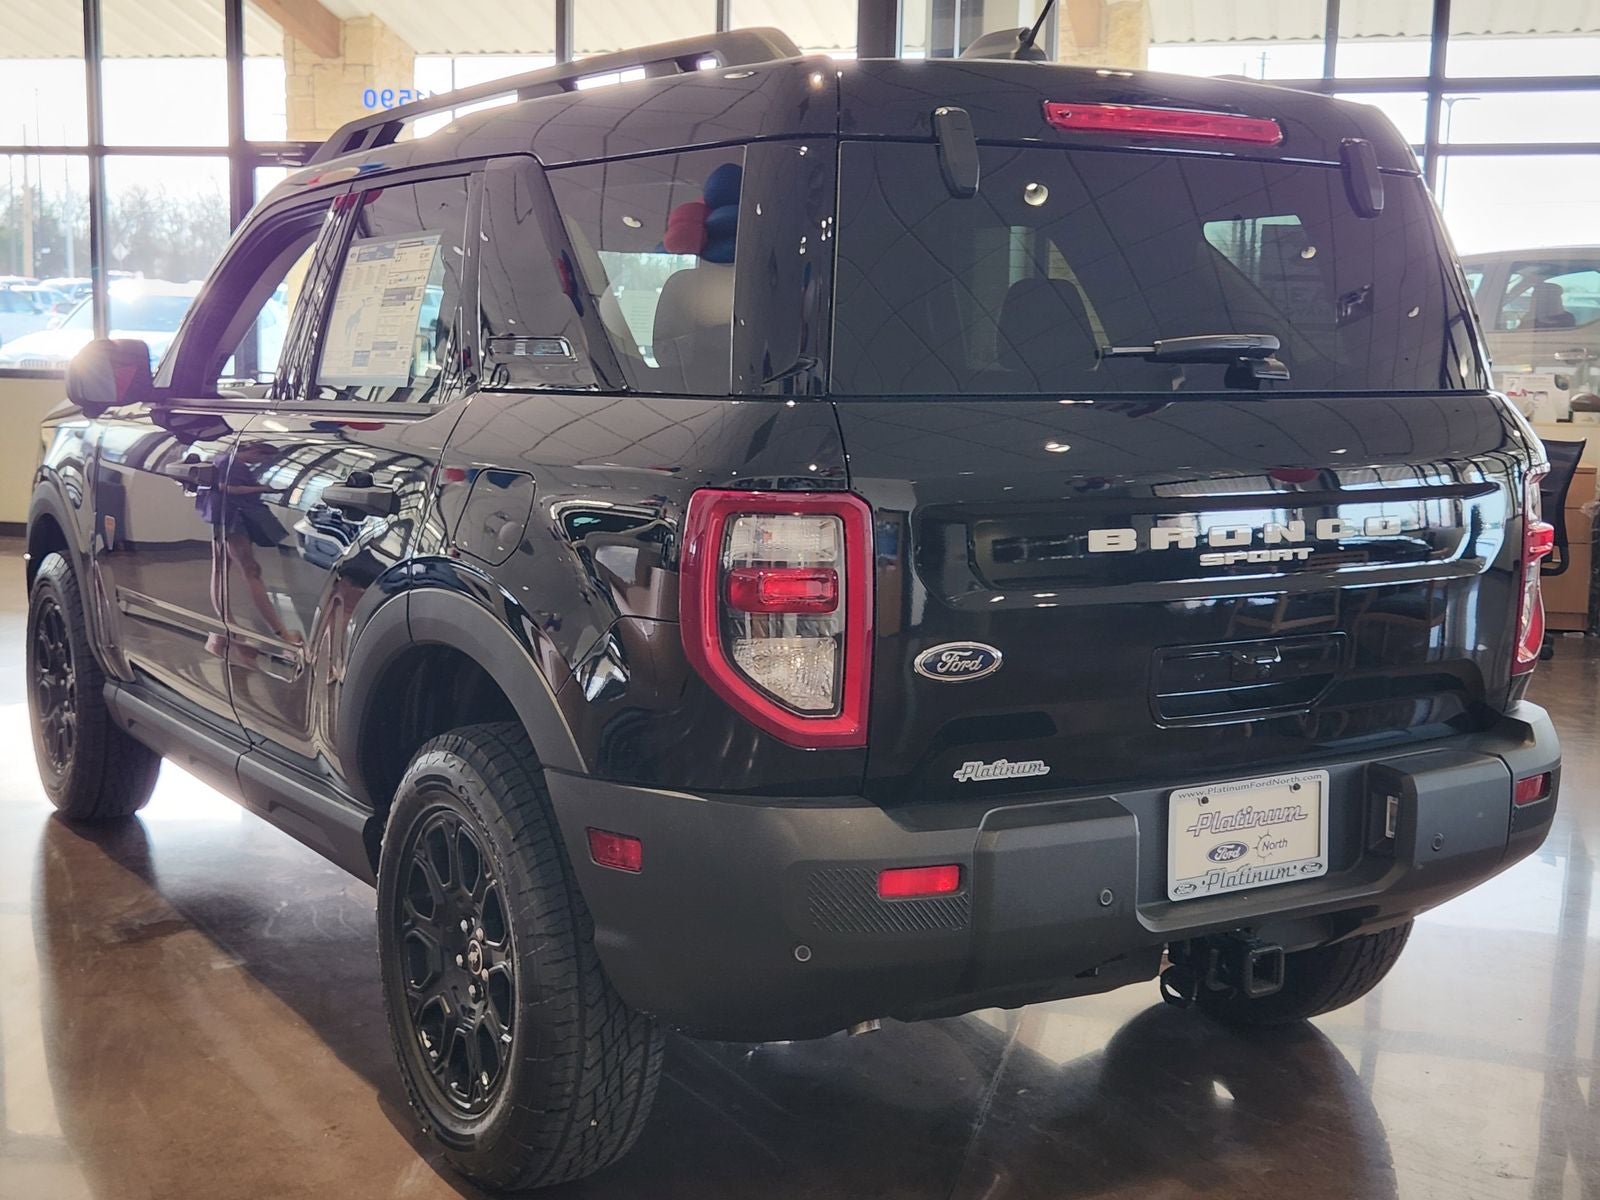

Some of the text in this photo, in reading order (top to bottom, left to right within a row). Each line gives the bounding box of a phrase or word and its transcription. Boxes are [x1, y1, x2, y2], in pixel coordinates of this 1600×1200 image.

[1088, 516, 1402, 552] BRONCO
[1199, 547, 1315, 567] SPORT
[936, 650, 984, 673] Ford
[953, 759, 1050, 783] Platinum
[1178, 773, 1322, 799] www.PlatinumFordNorth.com
[1186, 805, 1308, 837] Platinum
[1213, 844, 1241, 861] Ford
[1263, 838, 1288, 851] North
[1206, 864, 1296, 892] Platinum
